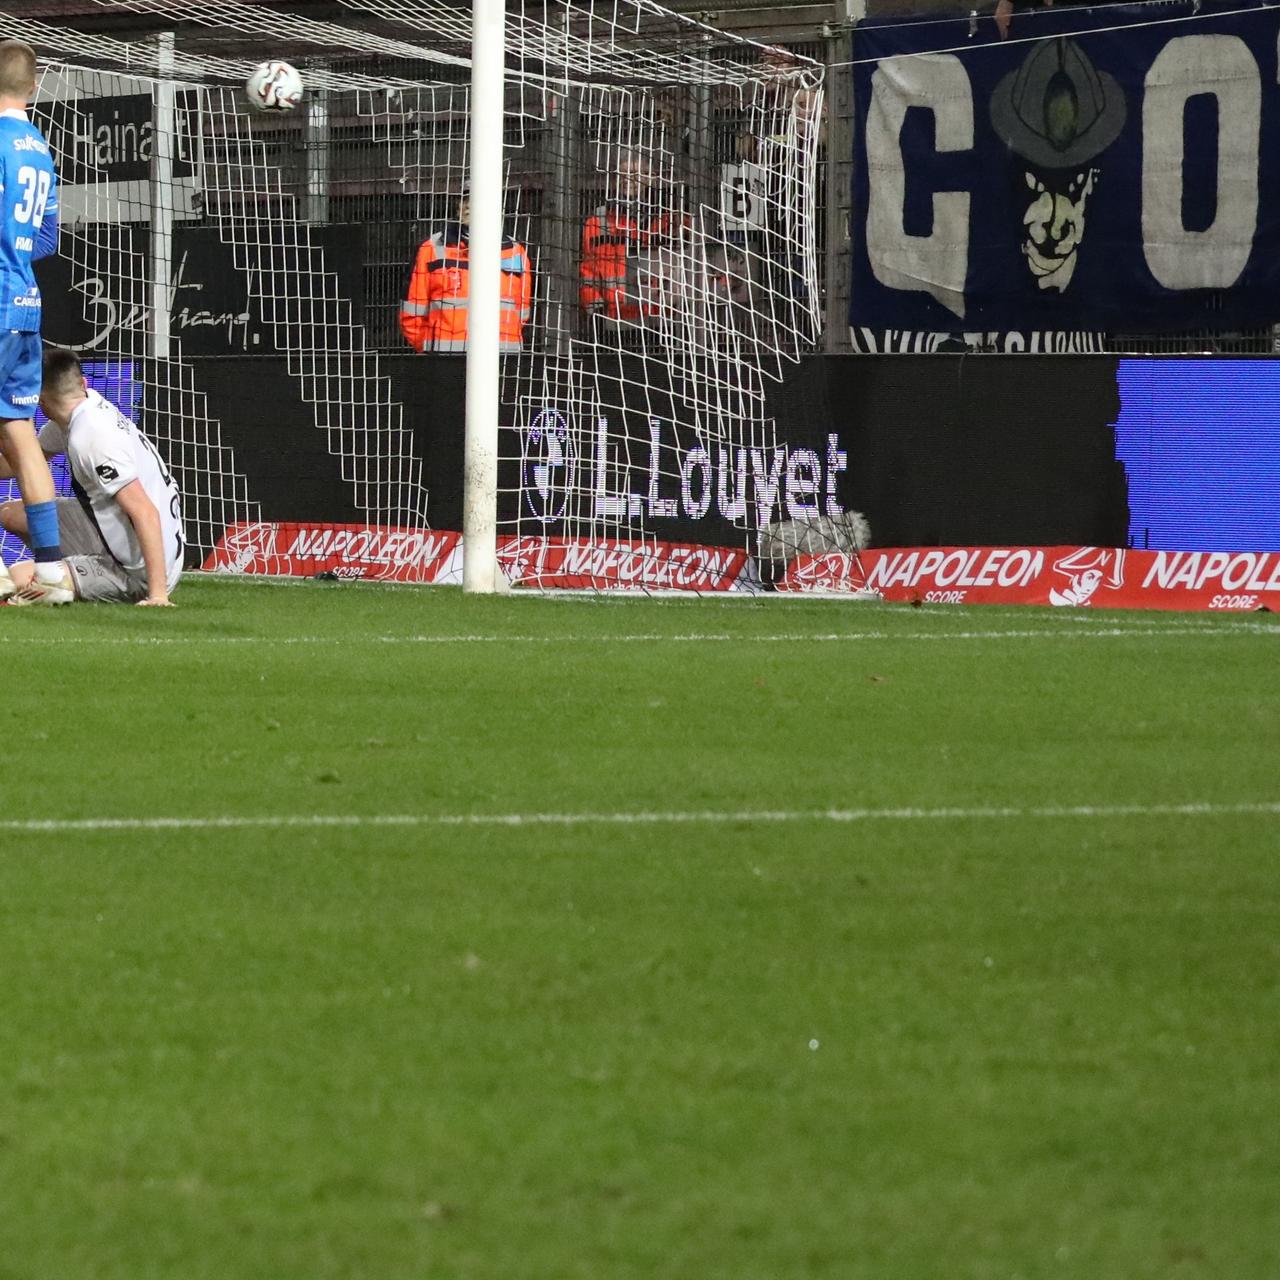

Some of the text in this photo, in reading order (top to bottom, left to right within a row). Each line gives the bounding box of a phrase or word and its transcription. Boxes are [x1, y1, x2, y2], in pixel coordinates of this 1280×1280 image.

[72, 107, 188, 170] Hainat
[285, 528, 449, 569] NAPOLEON
[563, 542, 736, 585] NAPOLEON
[923, 591, 968, 605] SCORE
[1208, 595, 1259, 609] SCORE
